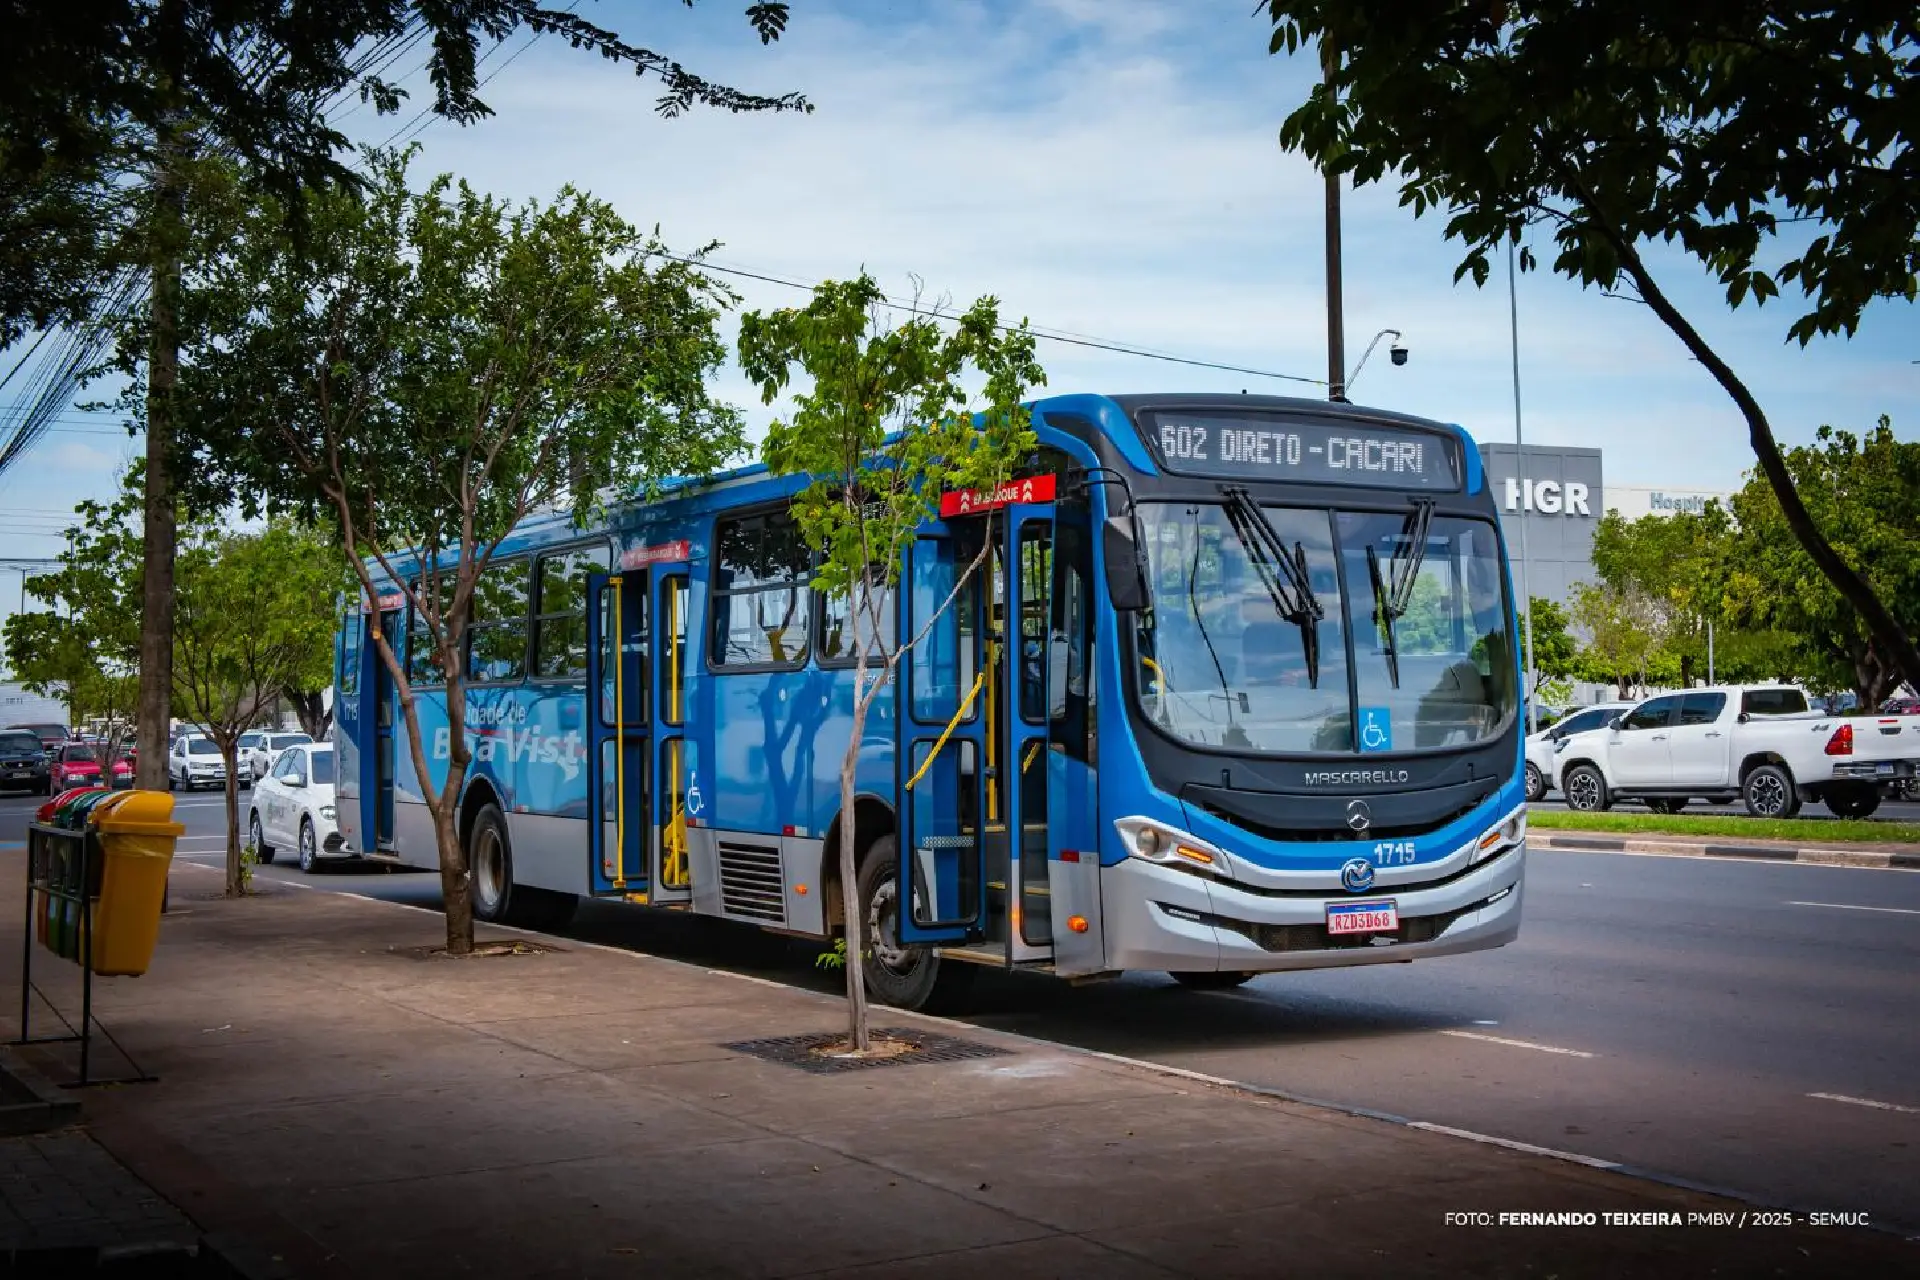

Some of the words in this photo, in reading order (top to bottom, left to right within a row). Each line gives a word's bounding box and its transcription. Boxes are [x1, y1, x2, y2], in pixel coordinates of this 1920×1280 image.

[1160, 425, 1208, 460] 602
[1219, 429, 1301, 465] DIRETO
[1504, 477, 1591, 517] HGR
[506, 725, 588, 764] Vist
[1305, 770, 1409, 786] MASCARELLO
[1374, 842, 1416, 864] 1715
